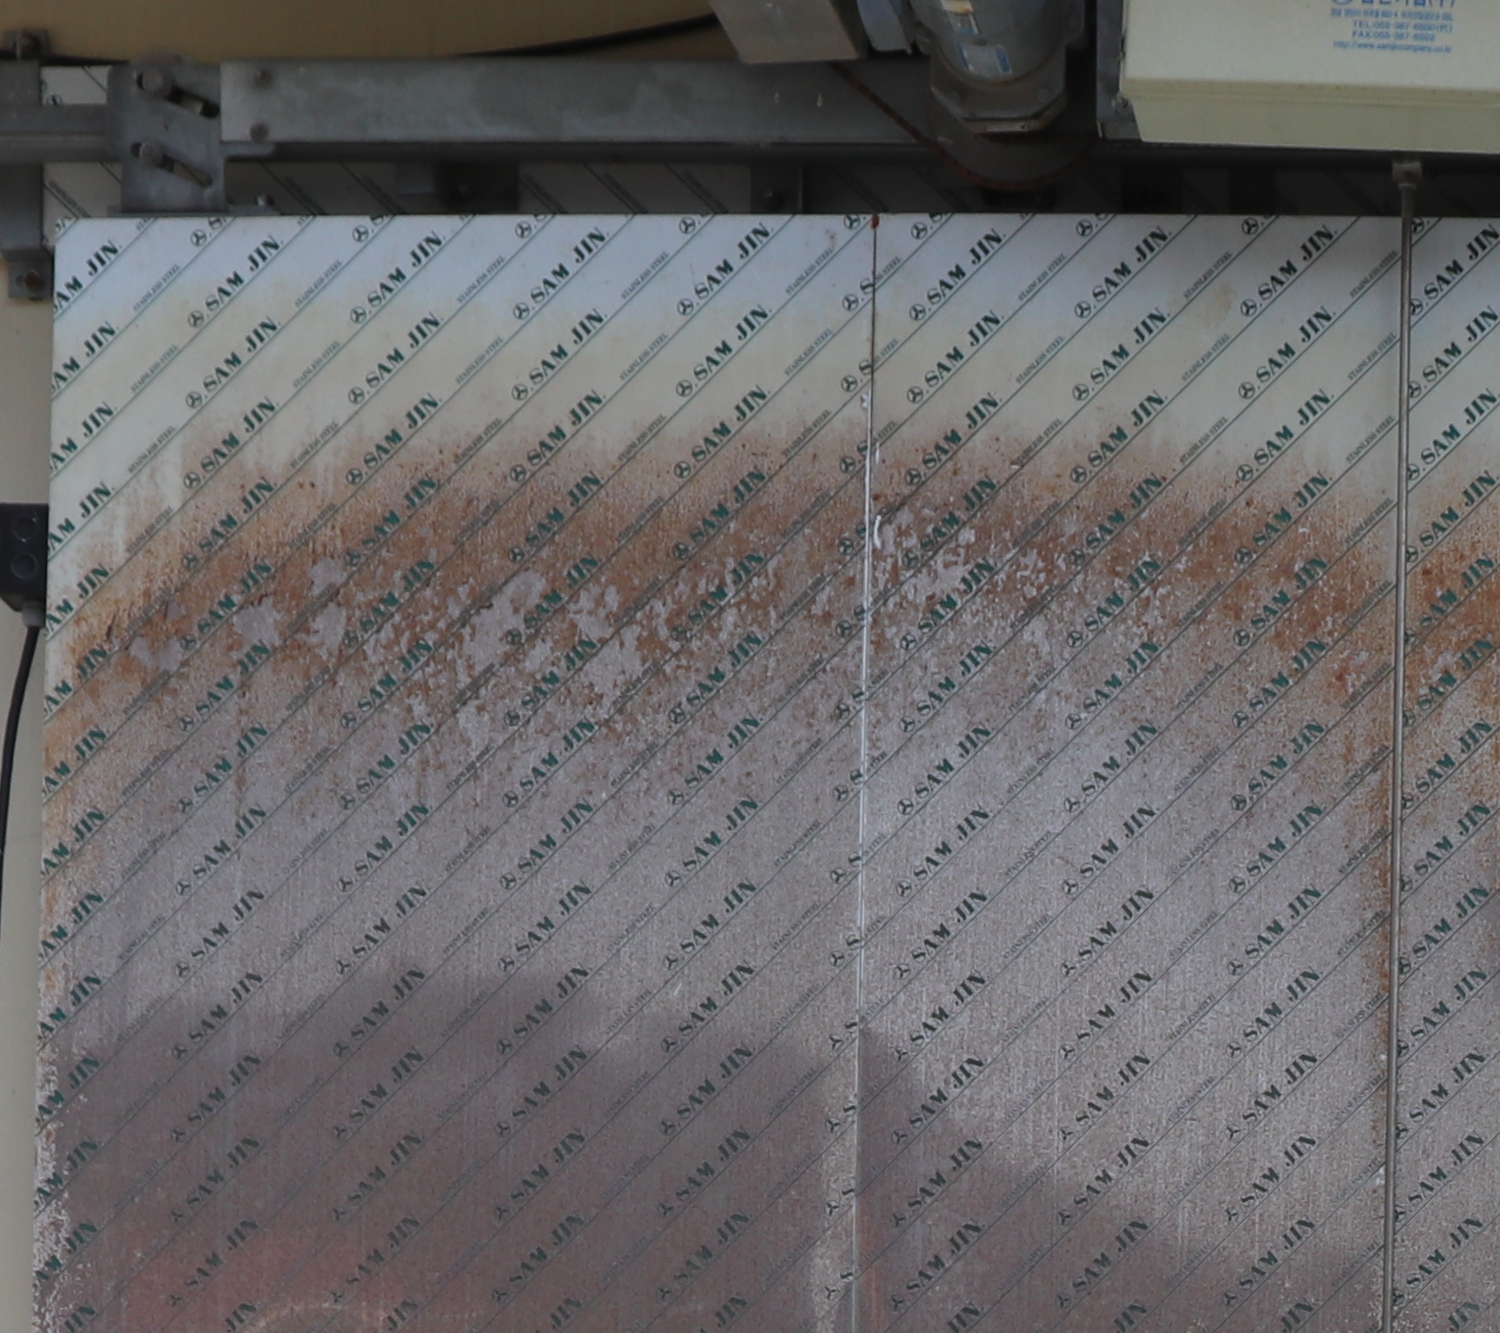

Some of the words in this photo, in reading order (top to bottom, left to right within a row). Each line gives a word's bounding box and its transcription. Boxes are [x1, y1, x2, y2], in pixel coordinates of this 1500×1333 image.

[204, 269, 245, 312] SAM
[366, 265, 407, 308] SAM
[529, 261, 570, 304] SAM
[694, 257, 735, 300] SAM
[926, 262, 967, 305] SAM
[1091, 260, 1132, 303] SAM
[1257, 258, 1298, 301] SAM
[1423, 258, 1464, 301] SAM
[202, 350, 243, 393] SAM
[364, 346, 405, 389] SAM
[528, 342, 569, 385] SAM
[692, 338, 733, 381] SAM
[924, 344, 965, 387] SAM
[1089, 342, 1130, 385] SAM
[1255, 340, 1296, 383] SAM
[1422, 340, 1463, 383] SAM
[200, 431, 241, 474] SAM
[362, 427, 403, 470] SAM
[526, 423, 567, 466] SAM
[691, 419, 732, 462] SAM
[922, 427, 963, 470] SAM
[1087, 424, 1128, 467] SAM
[1253, 423, 1294, 466] SAM
[1420, 422, 1461, 465] SAM
[197, 511, 238, 554] SAM
[360, 508, 401, 551] SAM
[524, 505, 565, 548] SAM
[689, 501, 730, 544] SAM
[1085, 507, 1126, 550] SAM
[1252, 505, 1293, 548] SAM
[1419, 504, 1460, 547] SAM
[191, 837, 232, 880] SAM
[353, 834, 394, 877] SAM
[682, 829, 723, 872] SAM
[912, 838, 953, 881] SAM
[1079, 836, 1120, 879] SAM
[1244, 917, 1285, 960] SAM
[1412, 916, 1453, 959] SAM
[187, 1002, 228, 1045] SAM
[512, 996, 553, 1039] SAM
[347, 1081, 388, 1124] SAM
[674, 1159, 715, 1202] SAM
[1240, 1165, 1281, 1208] SAM
[182, 1249, 223, 1292] SAM
[507, 1244, 548, 1287] SAM
[1072, 1250, 1113, 1293] SAM
[1405, 1247, 1446, 1290] SAM
